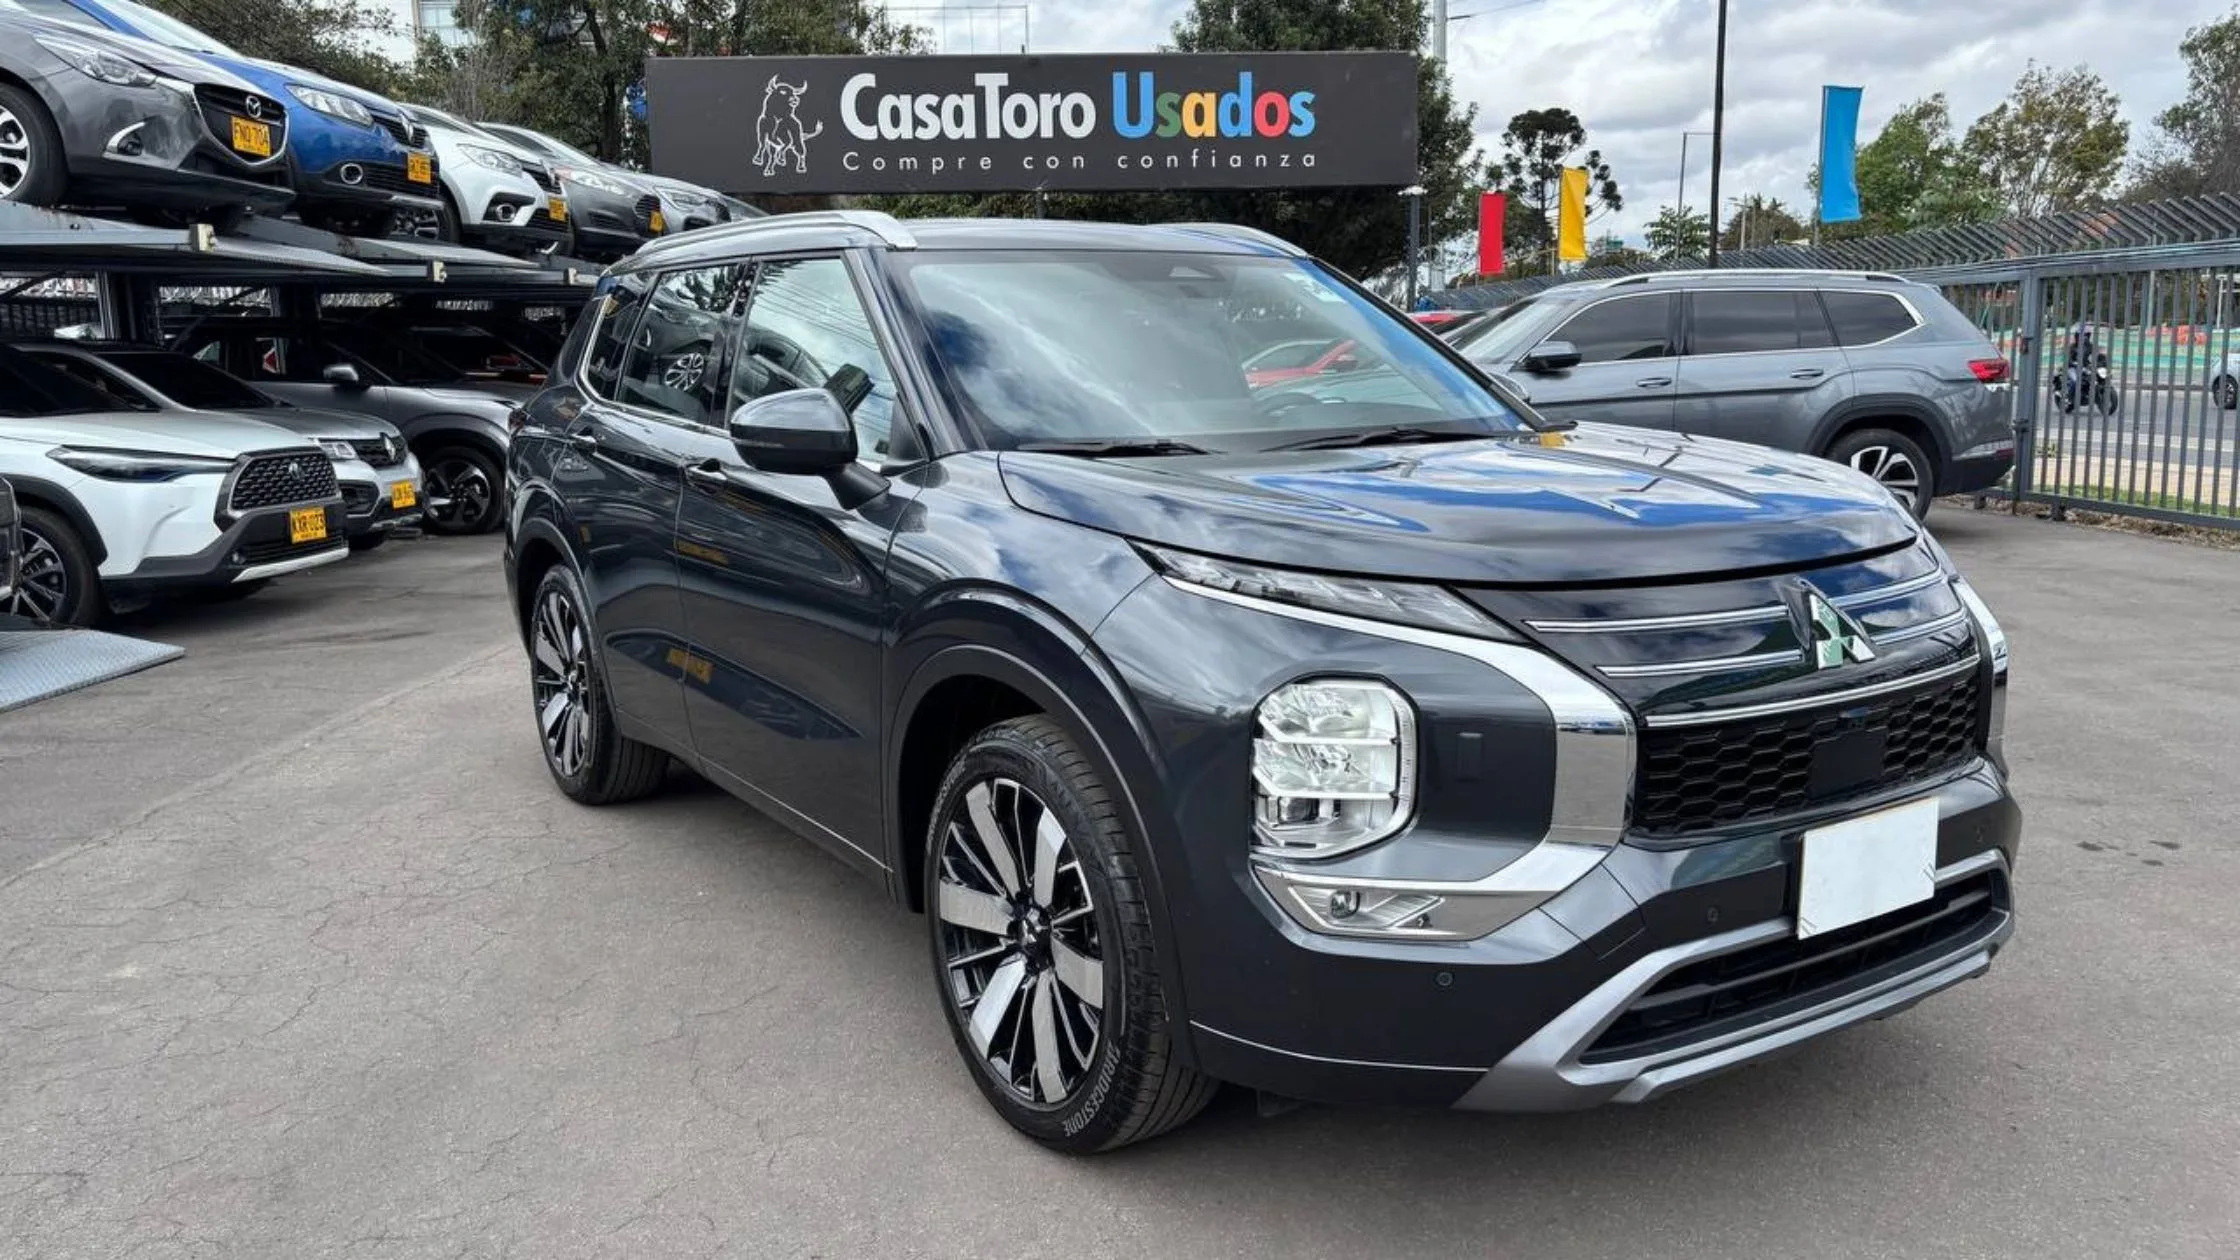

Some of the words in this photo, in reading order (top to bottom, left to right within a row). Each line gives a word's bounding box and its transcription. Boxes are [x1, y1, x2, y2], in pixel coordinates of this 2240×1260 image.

[840, 72, 1097, 140] CasaToro
[1112, 71, 1317, 139] Usados
[842, 151, 992, 175] Compre
[1022, 155, 1085, 170] con
[1116, 149, 1316, 170] confianza
